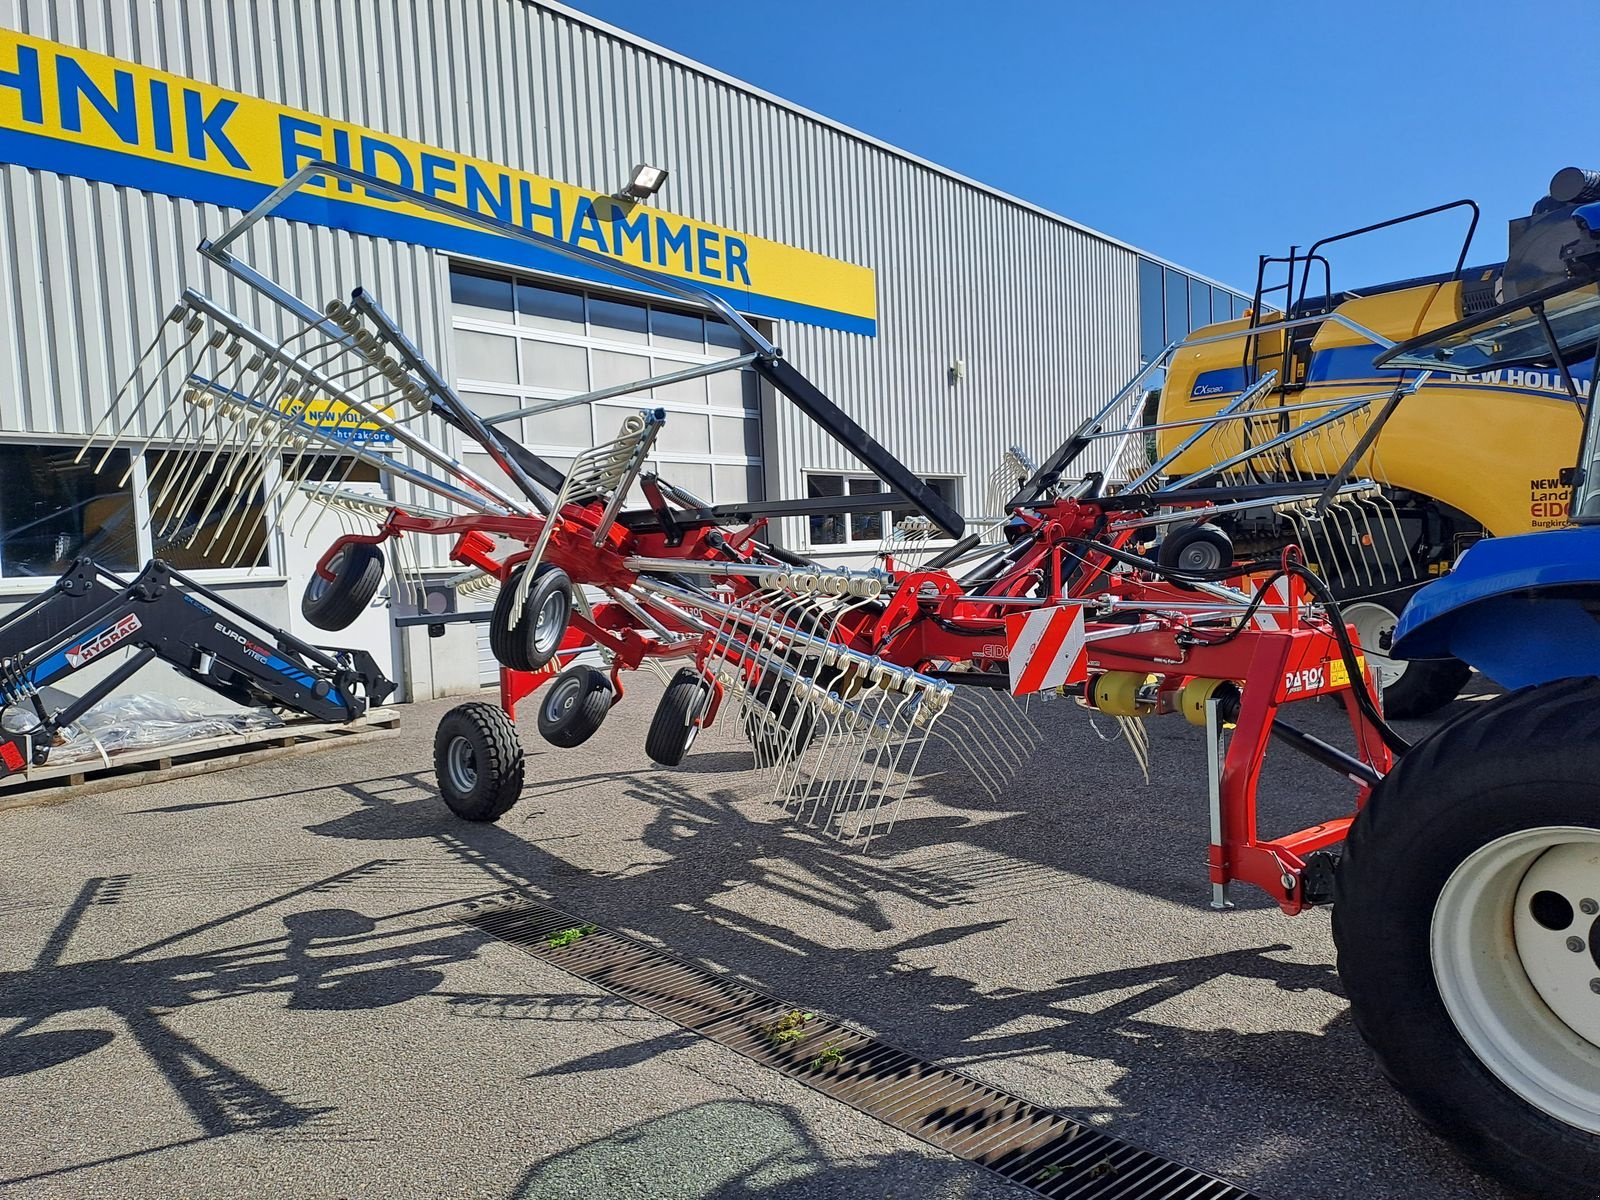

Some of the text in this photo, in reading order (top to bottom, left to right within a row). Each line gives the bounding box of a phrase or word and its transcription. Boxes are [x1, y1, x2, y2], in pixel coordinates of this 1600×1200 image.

[279, 114, 752, 286] EIDENHAMMER
[1450, 369, 1502, 385] NEW
[309, 411, 335, 421] NEW
[1530, 479, 1559, 490] NEW
[81, 621, 138, 661] HYDRAC
